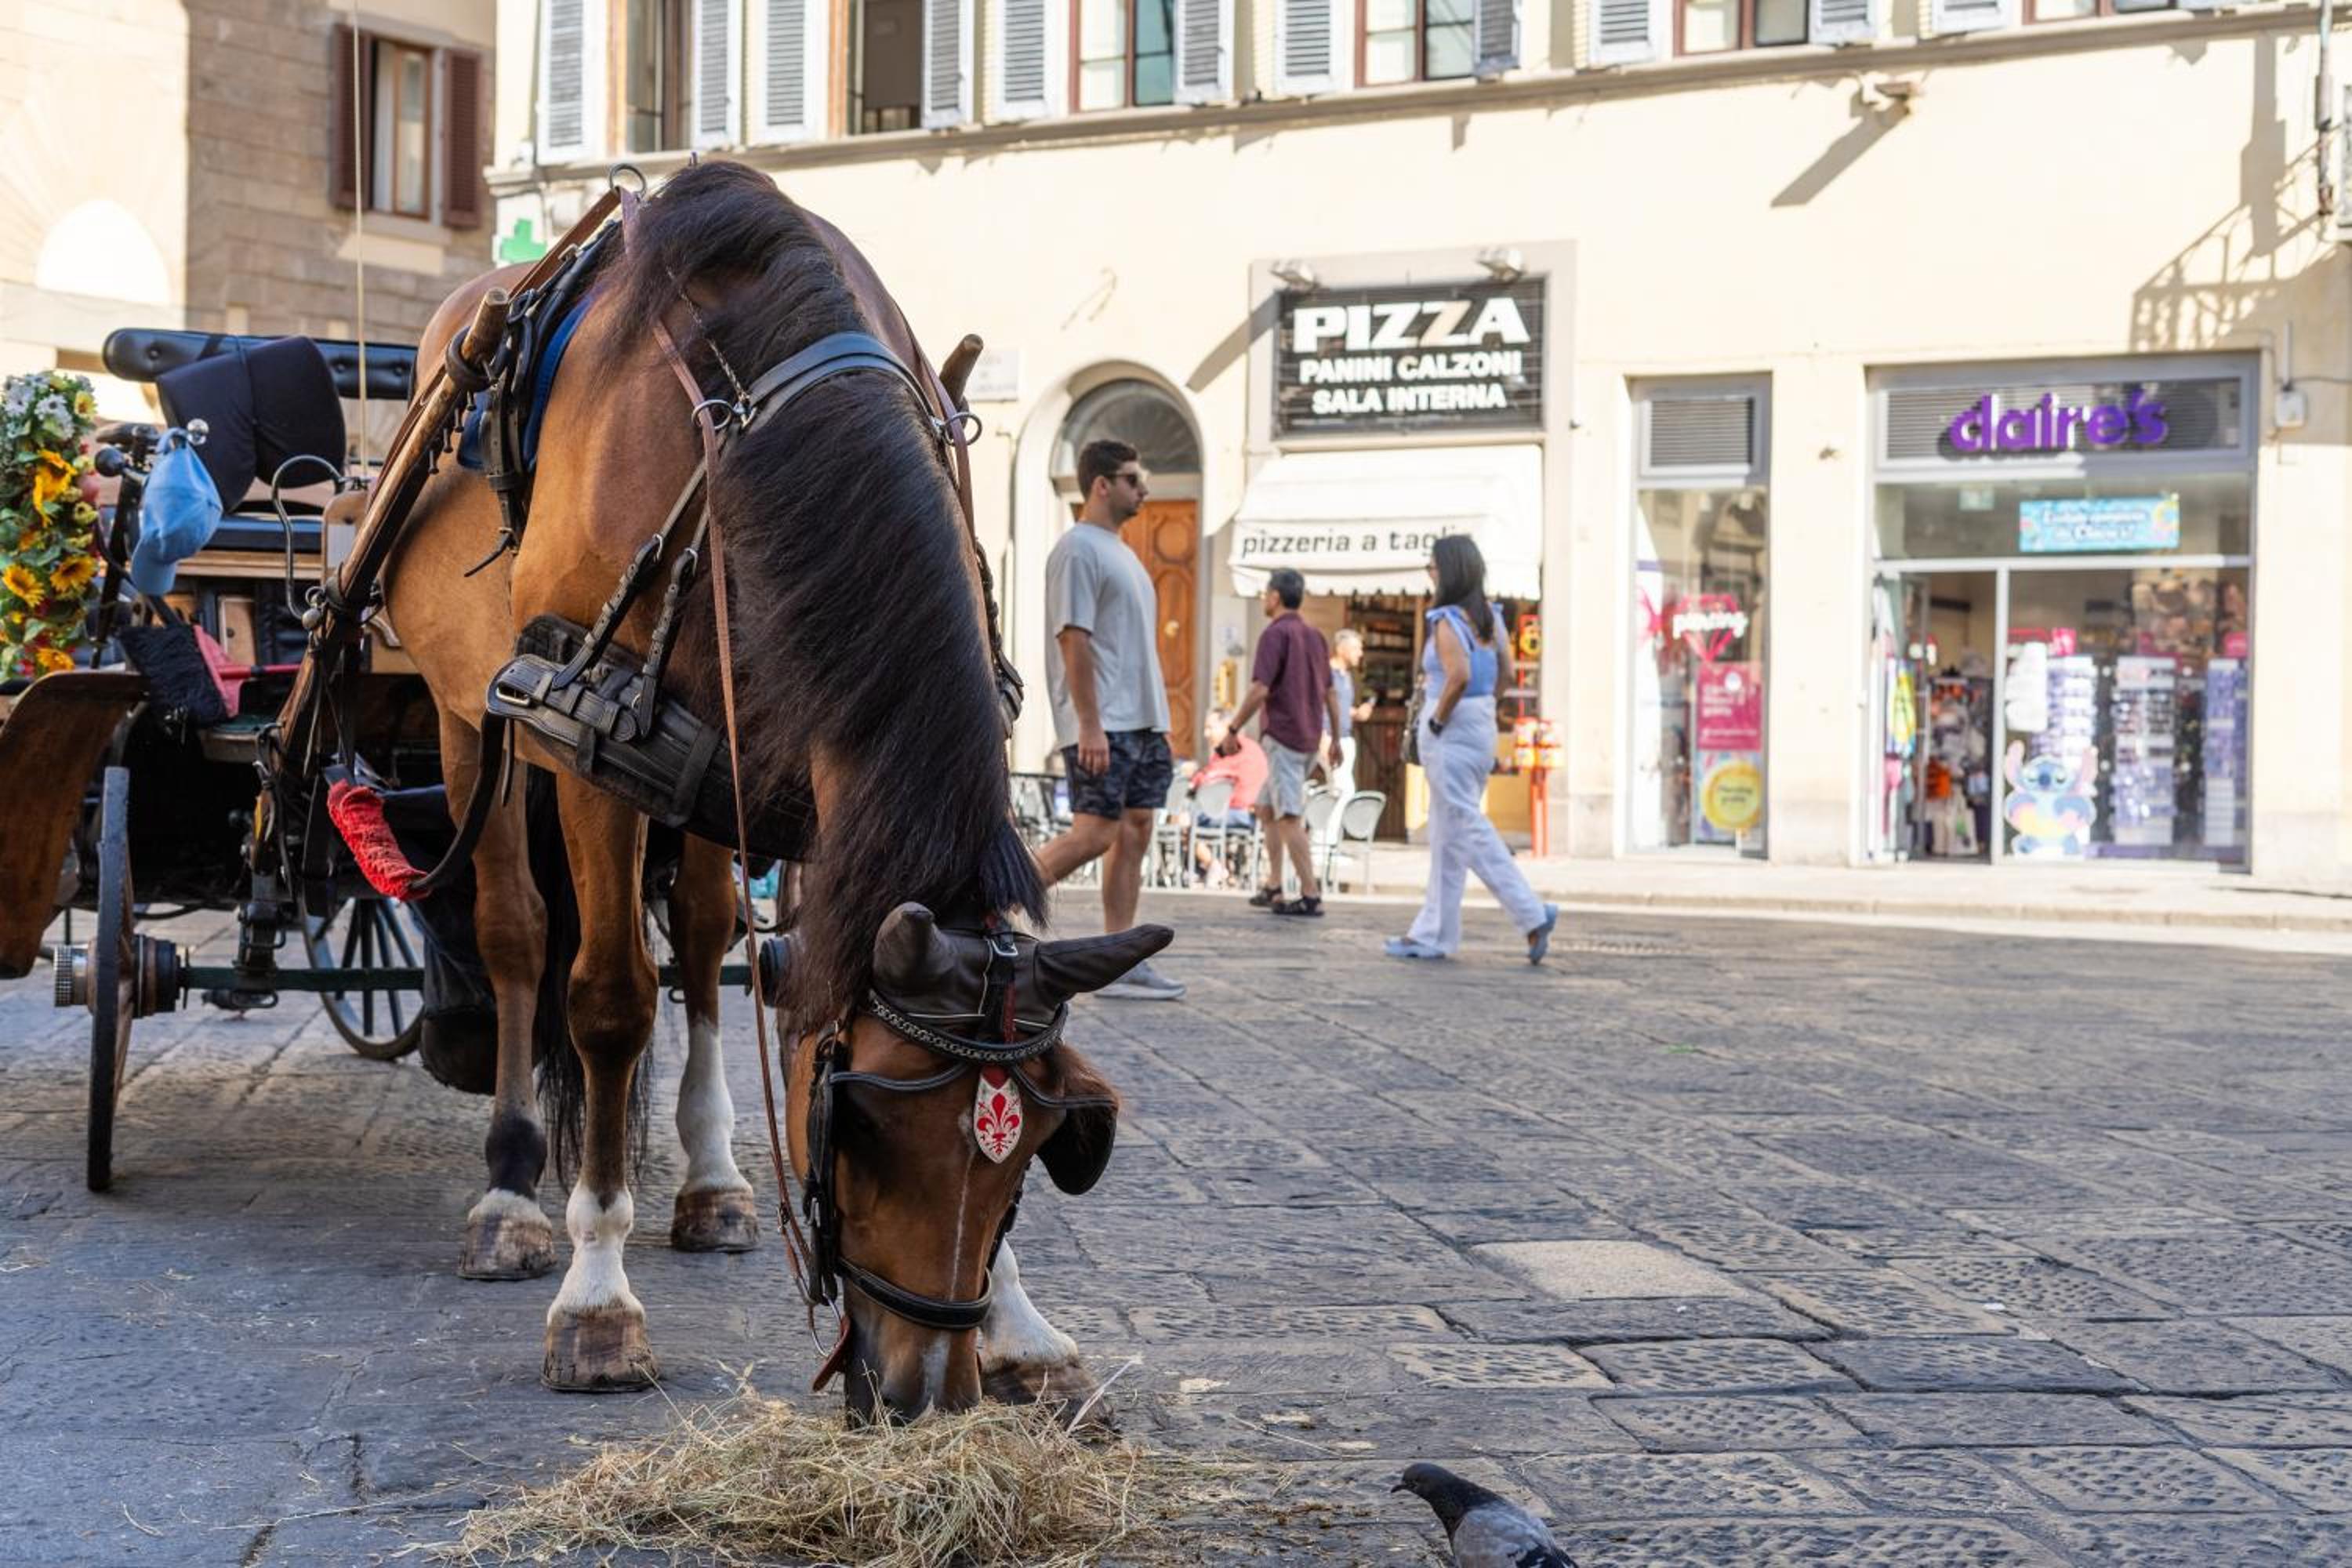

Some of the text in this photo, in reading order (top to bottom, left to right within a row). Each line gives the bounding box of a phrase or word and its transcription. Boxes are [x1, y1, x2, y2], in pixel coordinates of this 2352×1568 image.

[1294, 297, 1530, 353] PIZZA
[1299, 350, 1522, 384] PANINI CALZONI
[1312, 383, 1508, 414] SALA INTERNA
[1242, 528, 1351, 559] pizzeria
[1362, 535, 1377, 551] a
